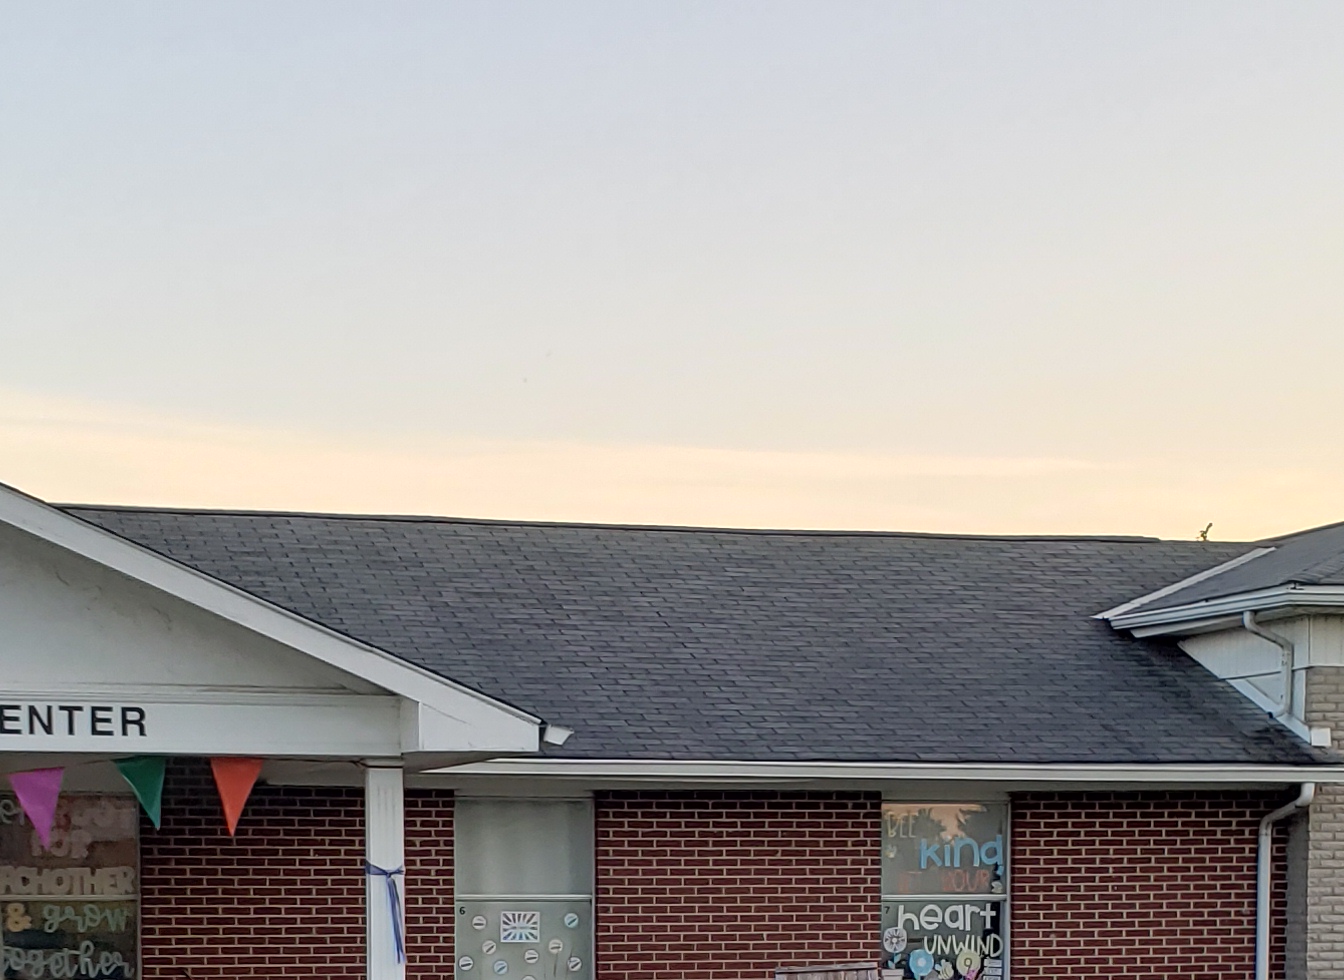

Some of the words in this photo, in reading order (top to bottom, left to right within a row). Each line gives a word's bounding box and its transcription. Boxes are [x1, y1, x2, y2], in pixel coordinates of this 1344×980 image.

[6, 902, 32, 933] &
[43, 903, 131, 933] grow
[459, 906, 466, 915] 6
[884, 905, 891, 914] 7
[897, 903, 996, 931] heart
[923, 933, 1004, 957] UNWIND
